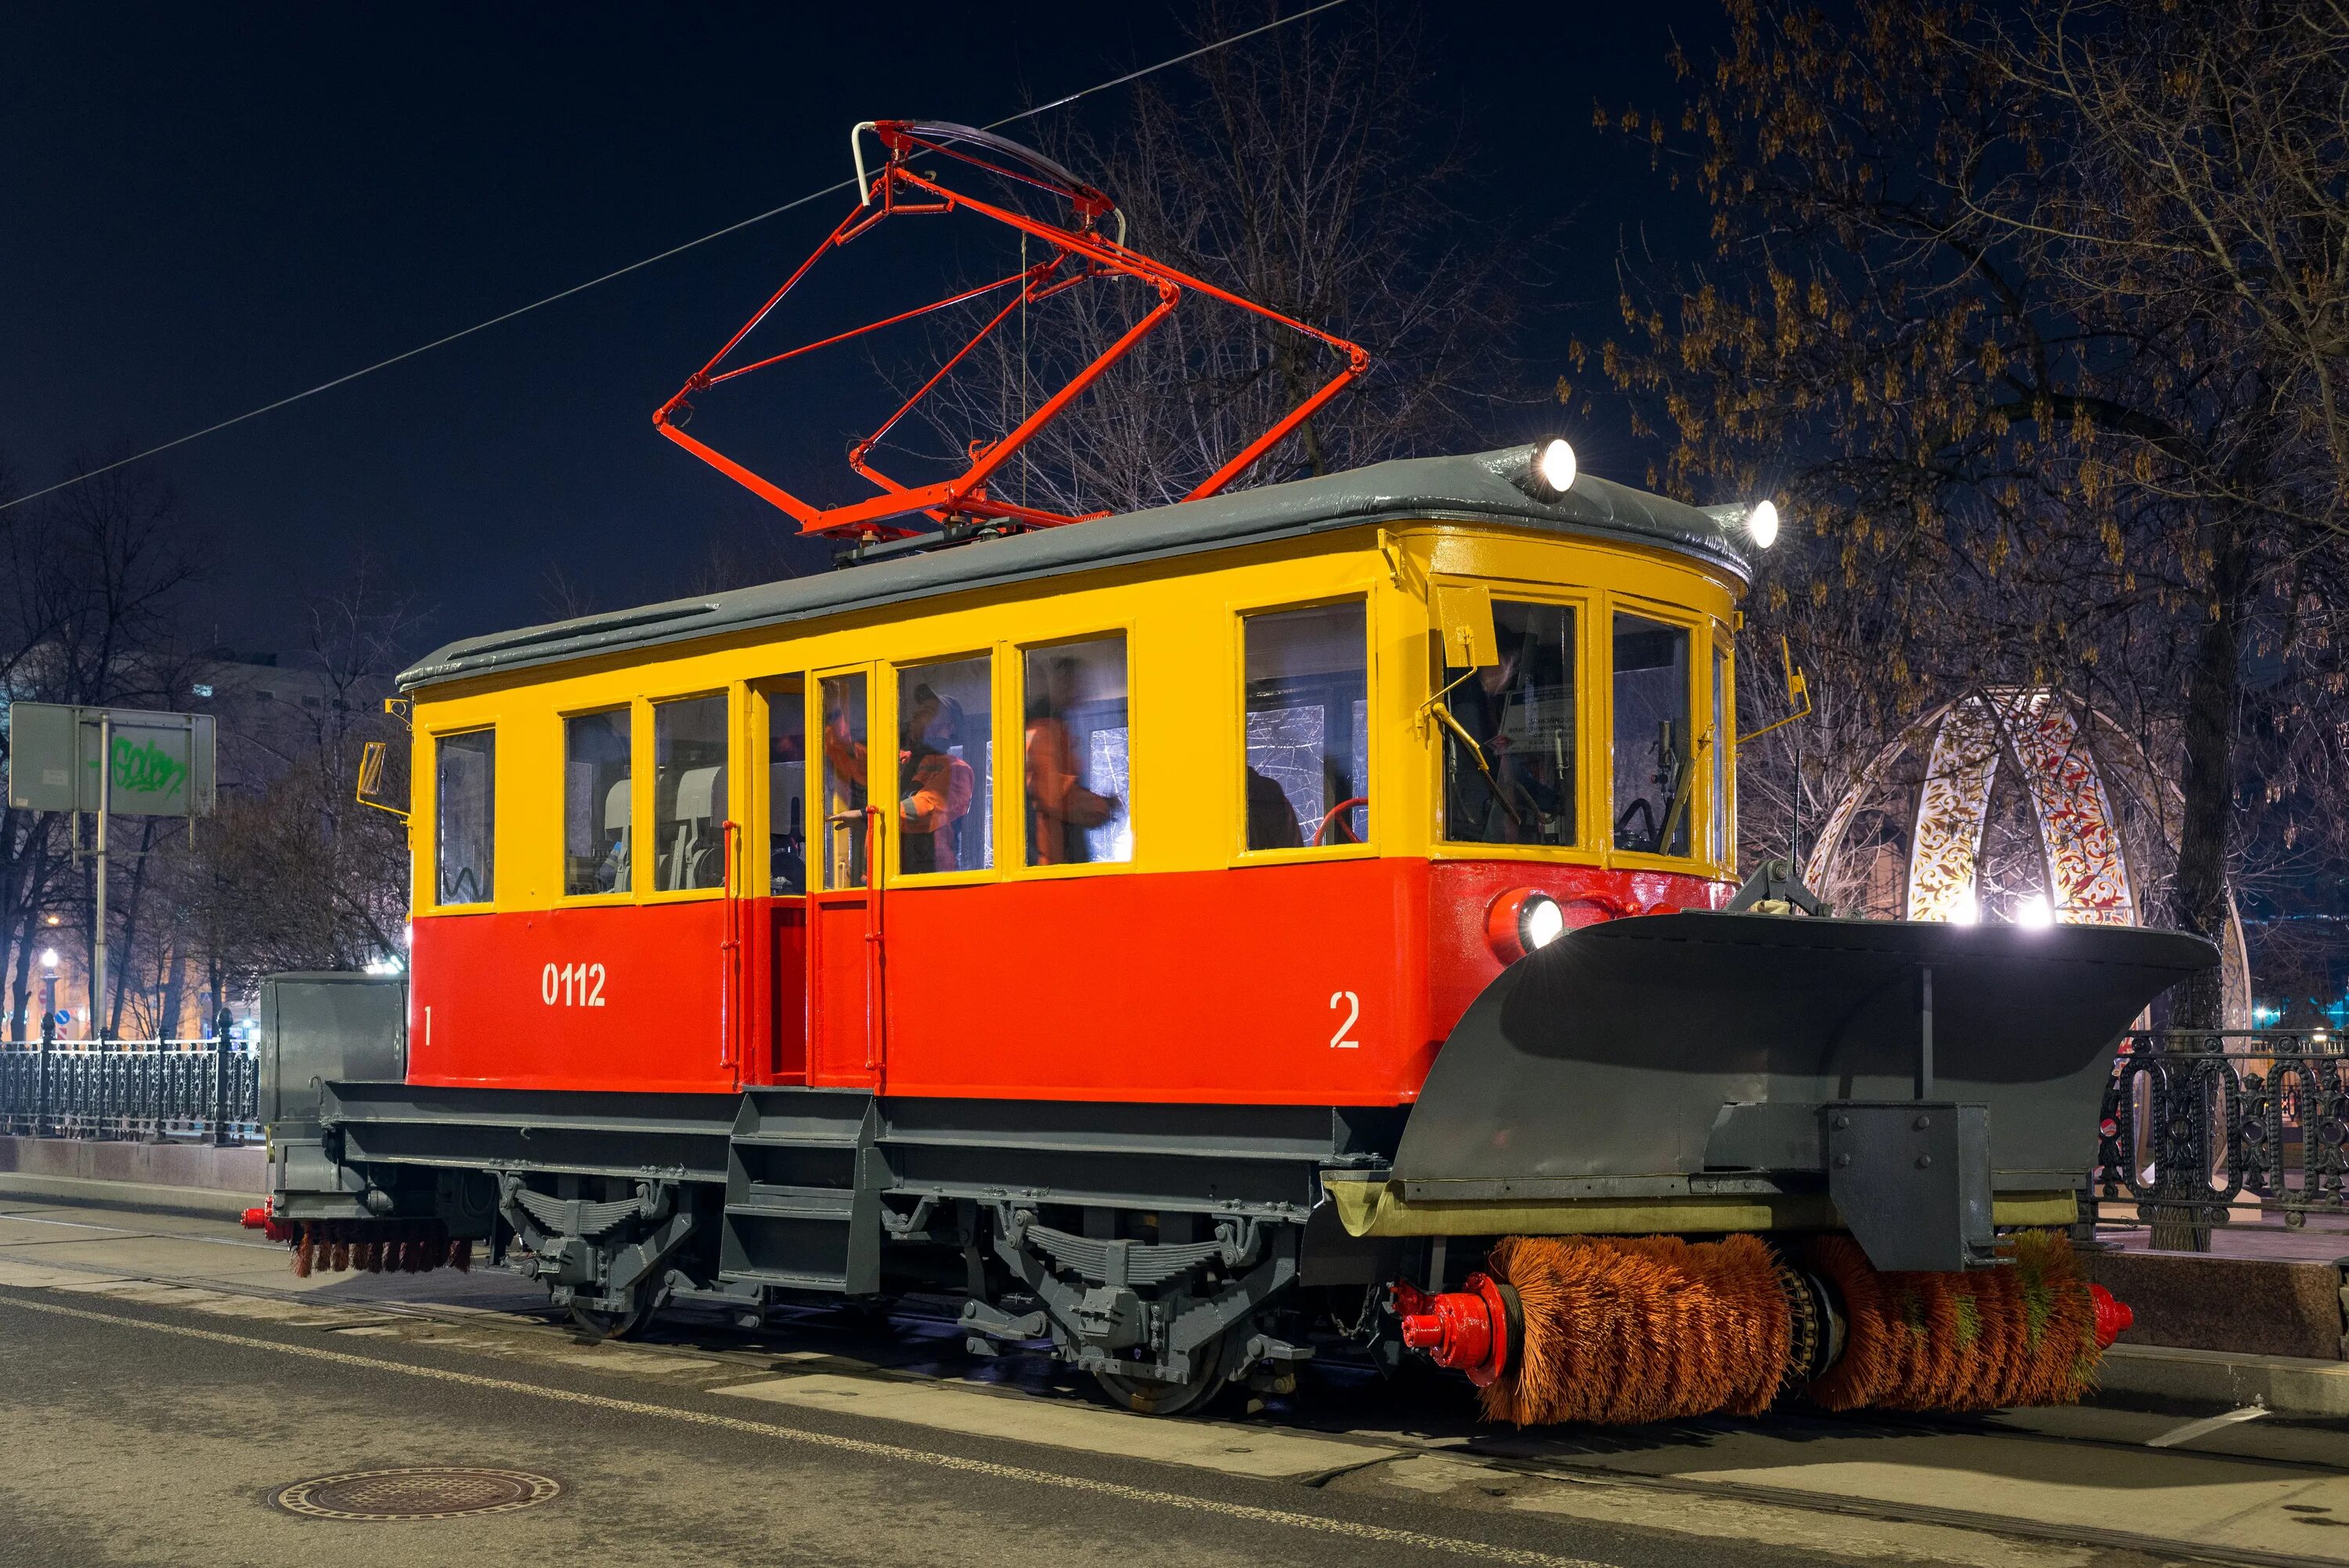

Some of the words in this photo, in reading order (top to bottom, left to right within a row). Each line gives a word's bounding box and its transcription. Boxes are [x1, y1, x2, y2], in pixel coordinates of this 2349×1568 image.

[542, 963, 605, 1007] 0112
[424, 1006, 431, 1046] 1
[1330, 991, 1359, 1048] 2
